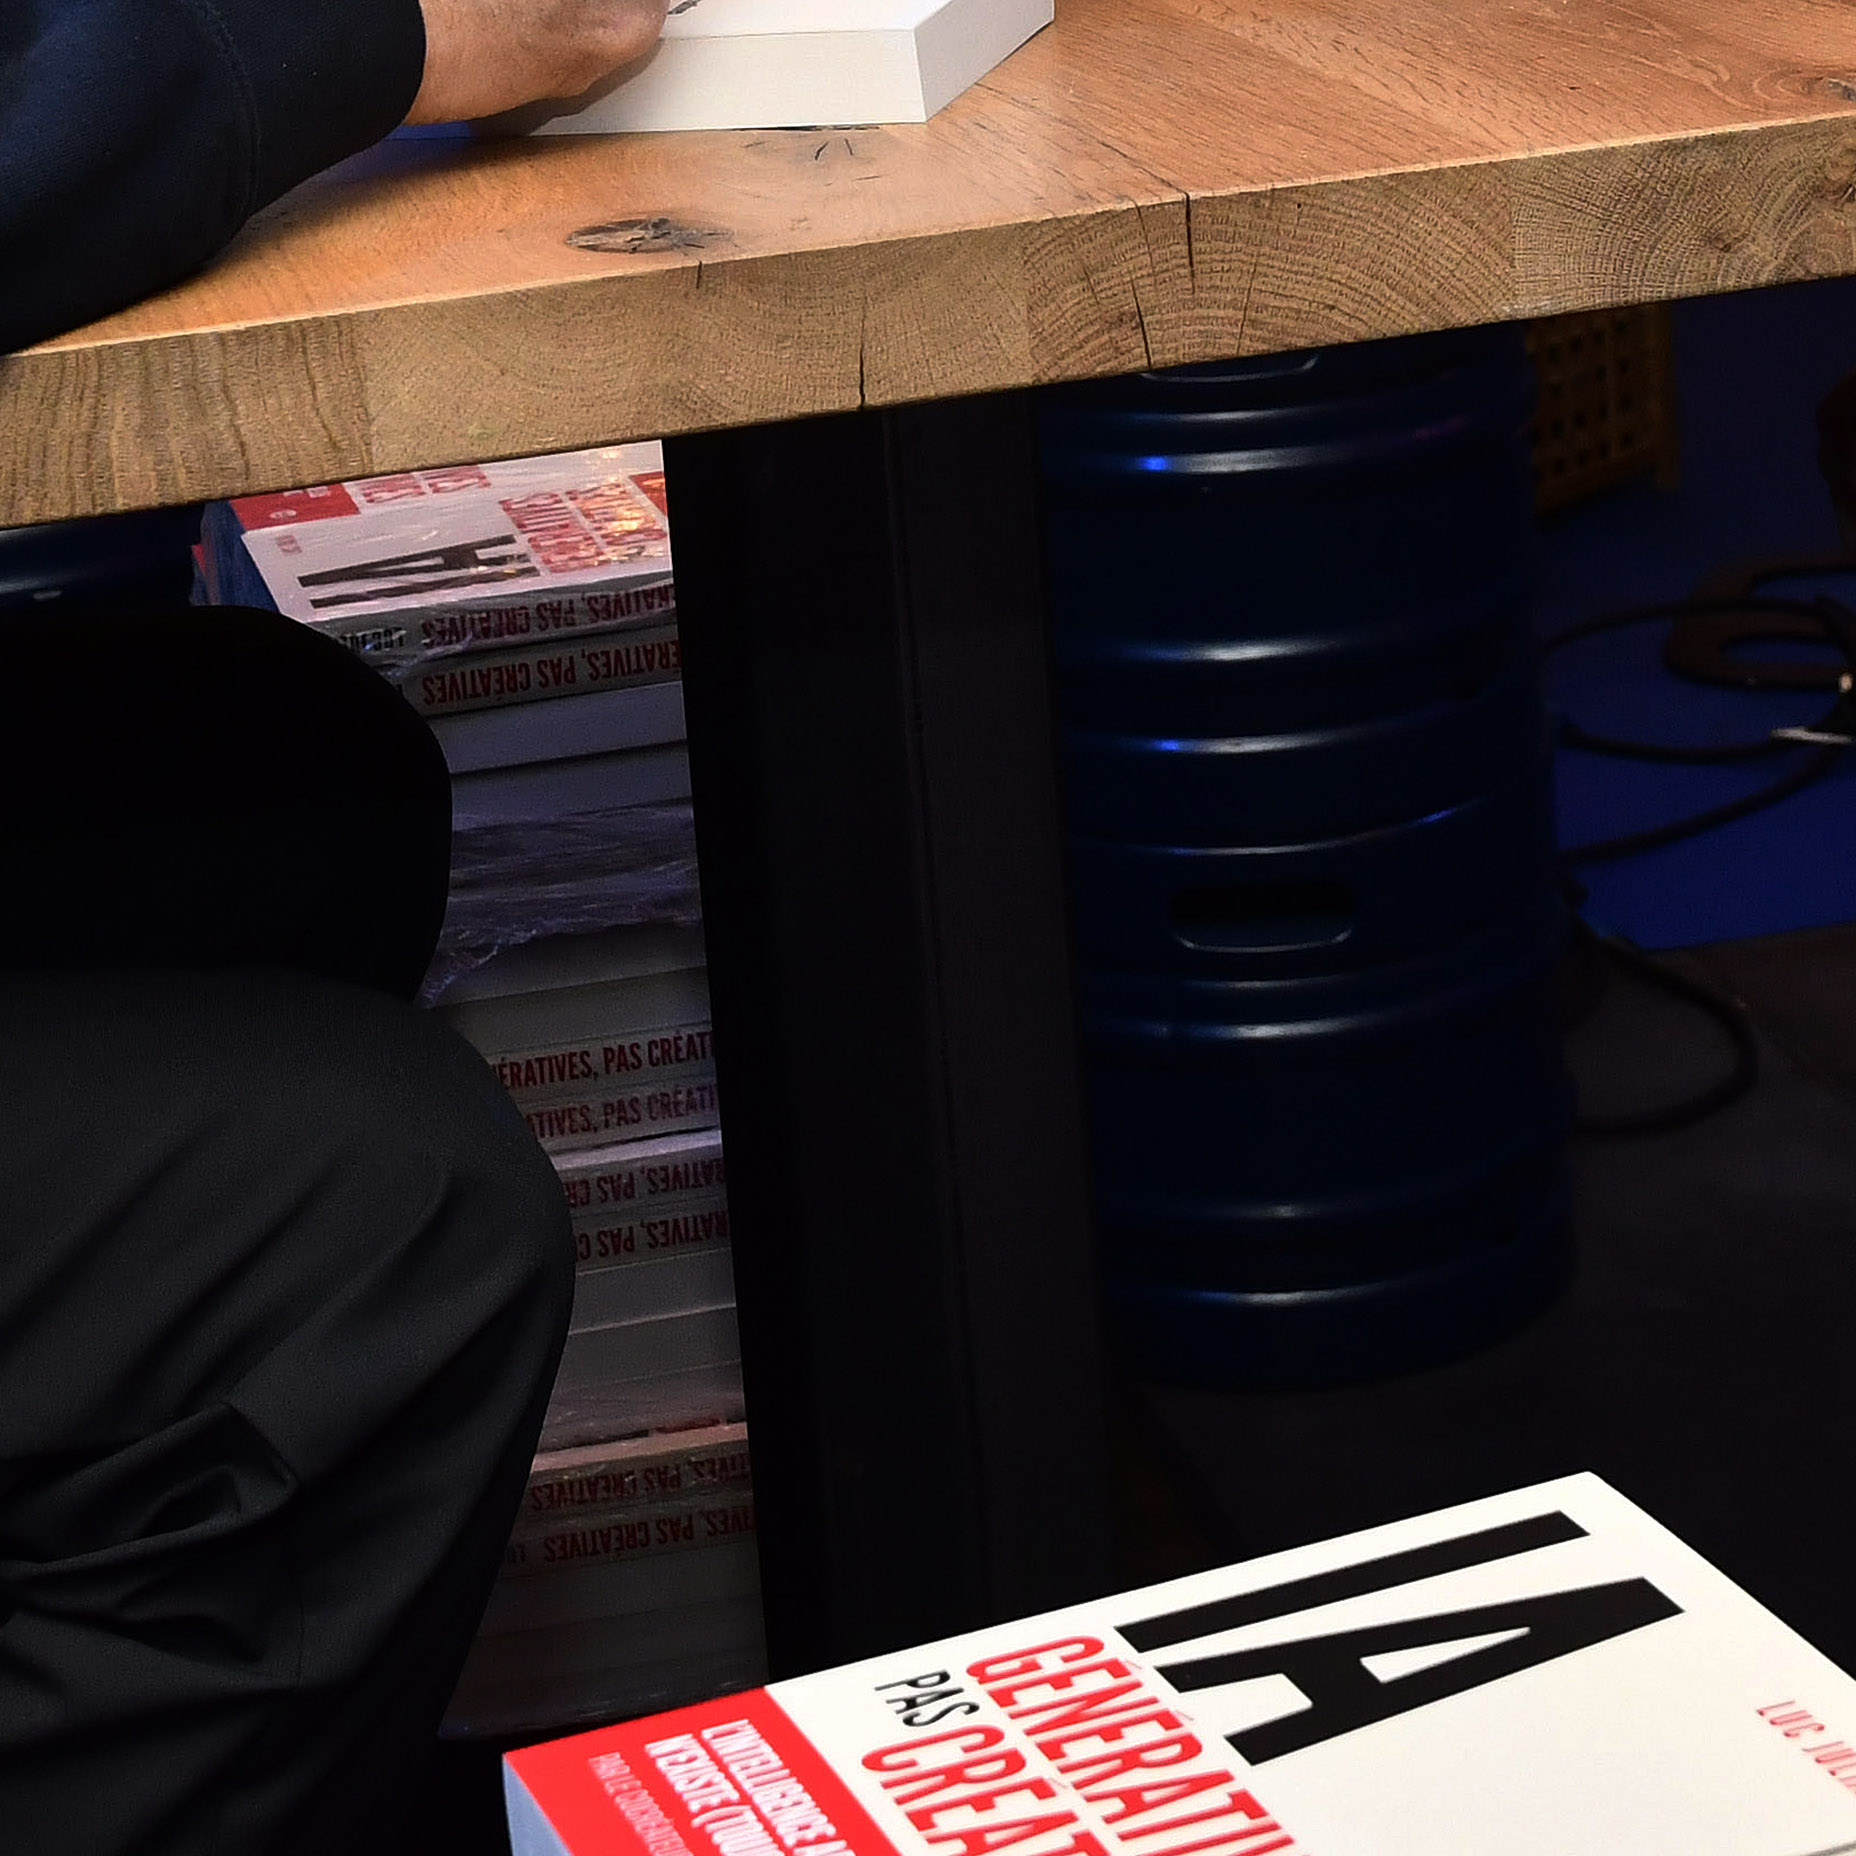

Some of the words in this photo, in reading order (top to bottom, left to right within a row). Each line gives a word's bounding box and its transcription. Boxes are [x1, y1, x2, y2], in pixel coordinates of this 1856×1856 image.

[422, 661, 531, 706] CRÉATIVES
[537, 654, 576, 690] PAS
[493, 1049, 599, 1091] ÉRATIVES,
[603, 1042, 642, 1075] PAS
[603, 1096, 642, 1129] PAS
[596, 1172, 636, 1204] PAS
[597, 1226, 635, 1258] PAS
[643, 1464, 682, 1494] PAS
[655, 1515, 695, 1544] PAS
[1113, 1509, 1686, 1766] IA
[873, 1669, 980, 1728] PAS
[1756, 1699, 1826, 1738] LUC
[701, 1718, 836, 1848] L'INTELLIGENCE
